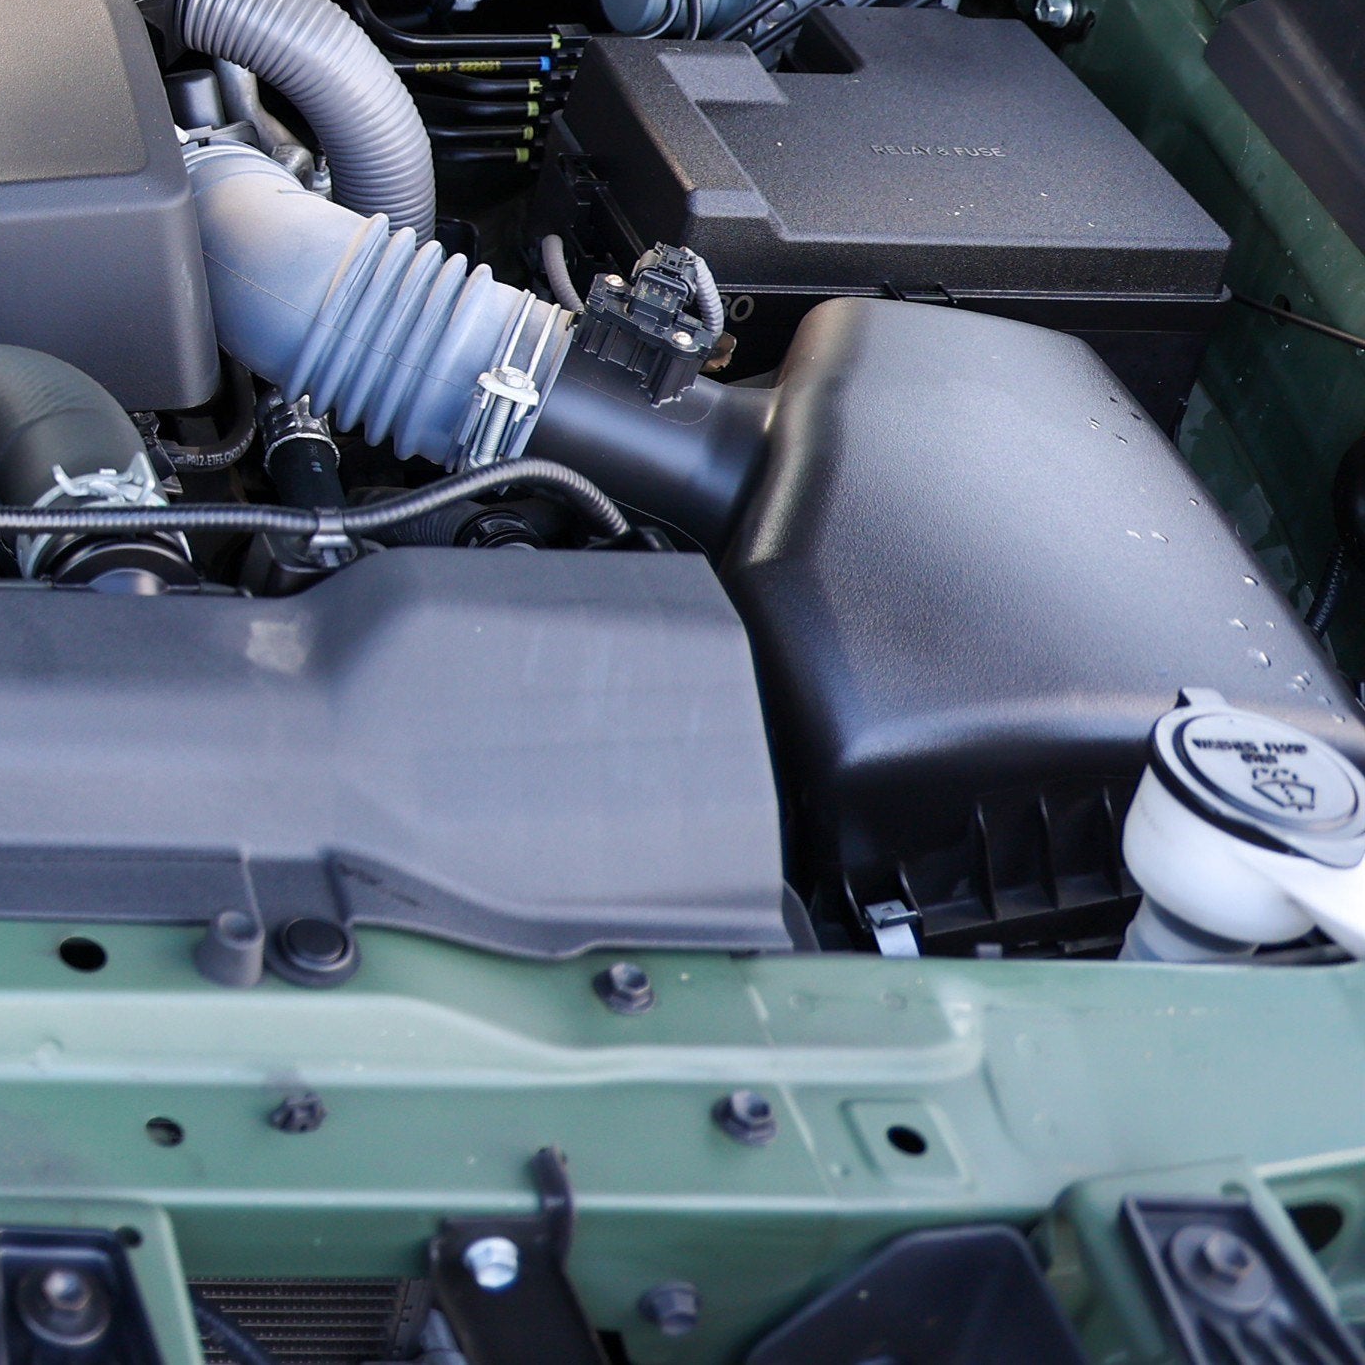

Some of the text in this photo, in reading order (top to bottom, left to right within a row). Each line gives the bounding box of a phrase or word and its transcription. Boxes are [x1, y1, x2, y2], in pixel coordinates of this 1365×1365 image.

[870, 144, 1007, 158] RELAY & FUSE
